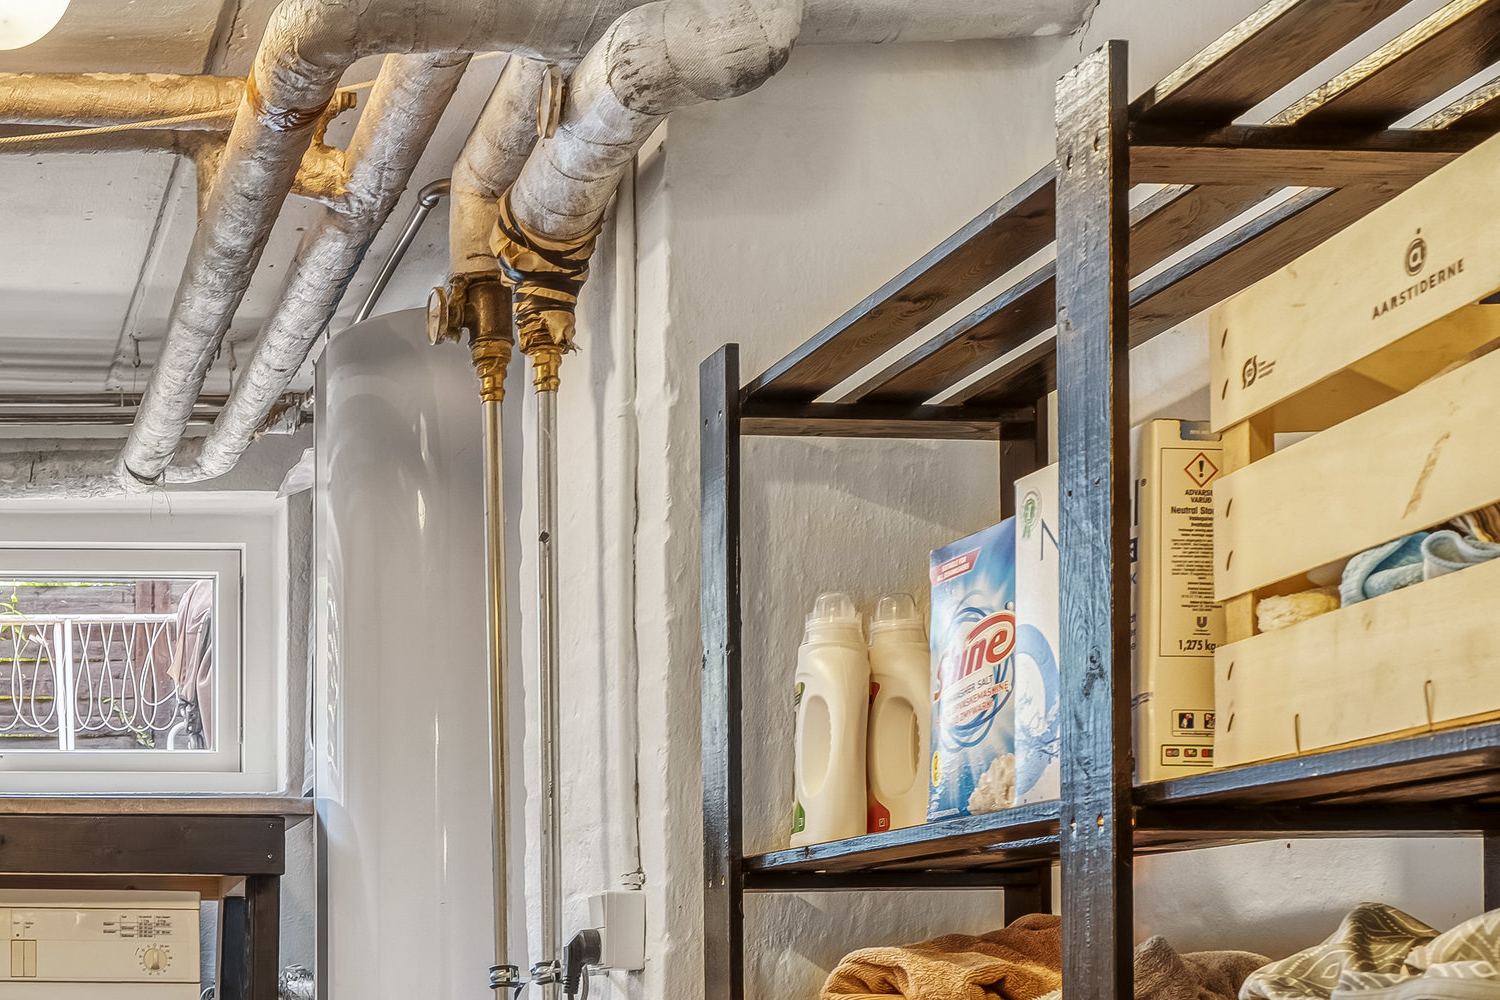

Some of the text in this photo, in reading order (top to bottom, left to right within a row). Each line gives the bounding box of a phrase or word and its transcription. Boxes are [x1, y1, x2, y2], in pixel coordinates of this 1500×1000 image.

[1372, 258, 1465, 320] AARSTIDERNE
[1171, 506, 1198, 514] Neutral
[1178, 639, 1217, 653] 1,275 kg
[977, 673, 994, 690] SALT
